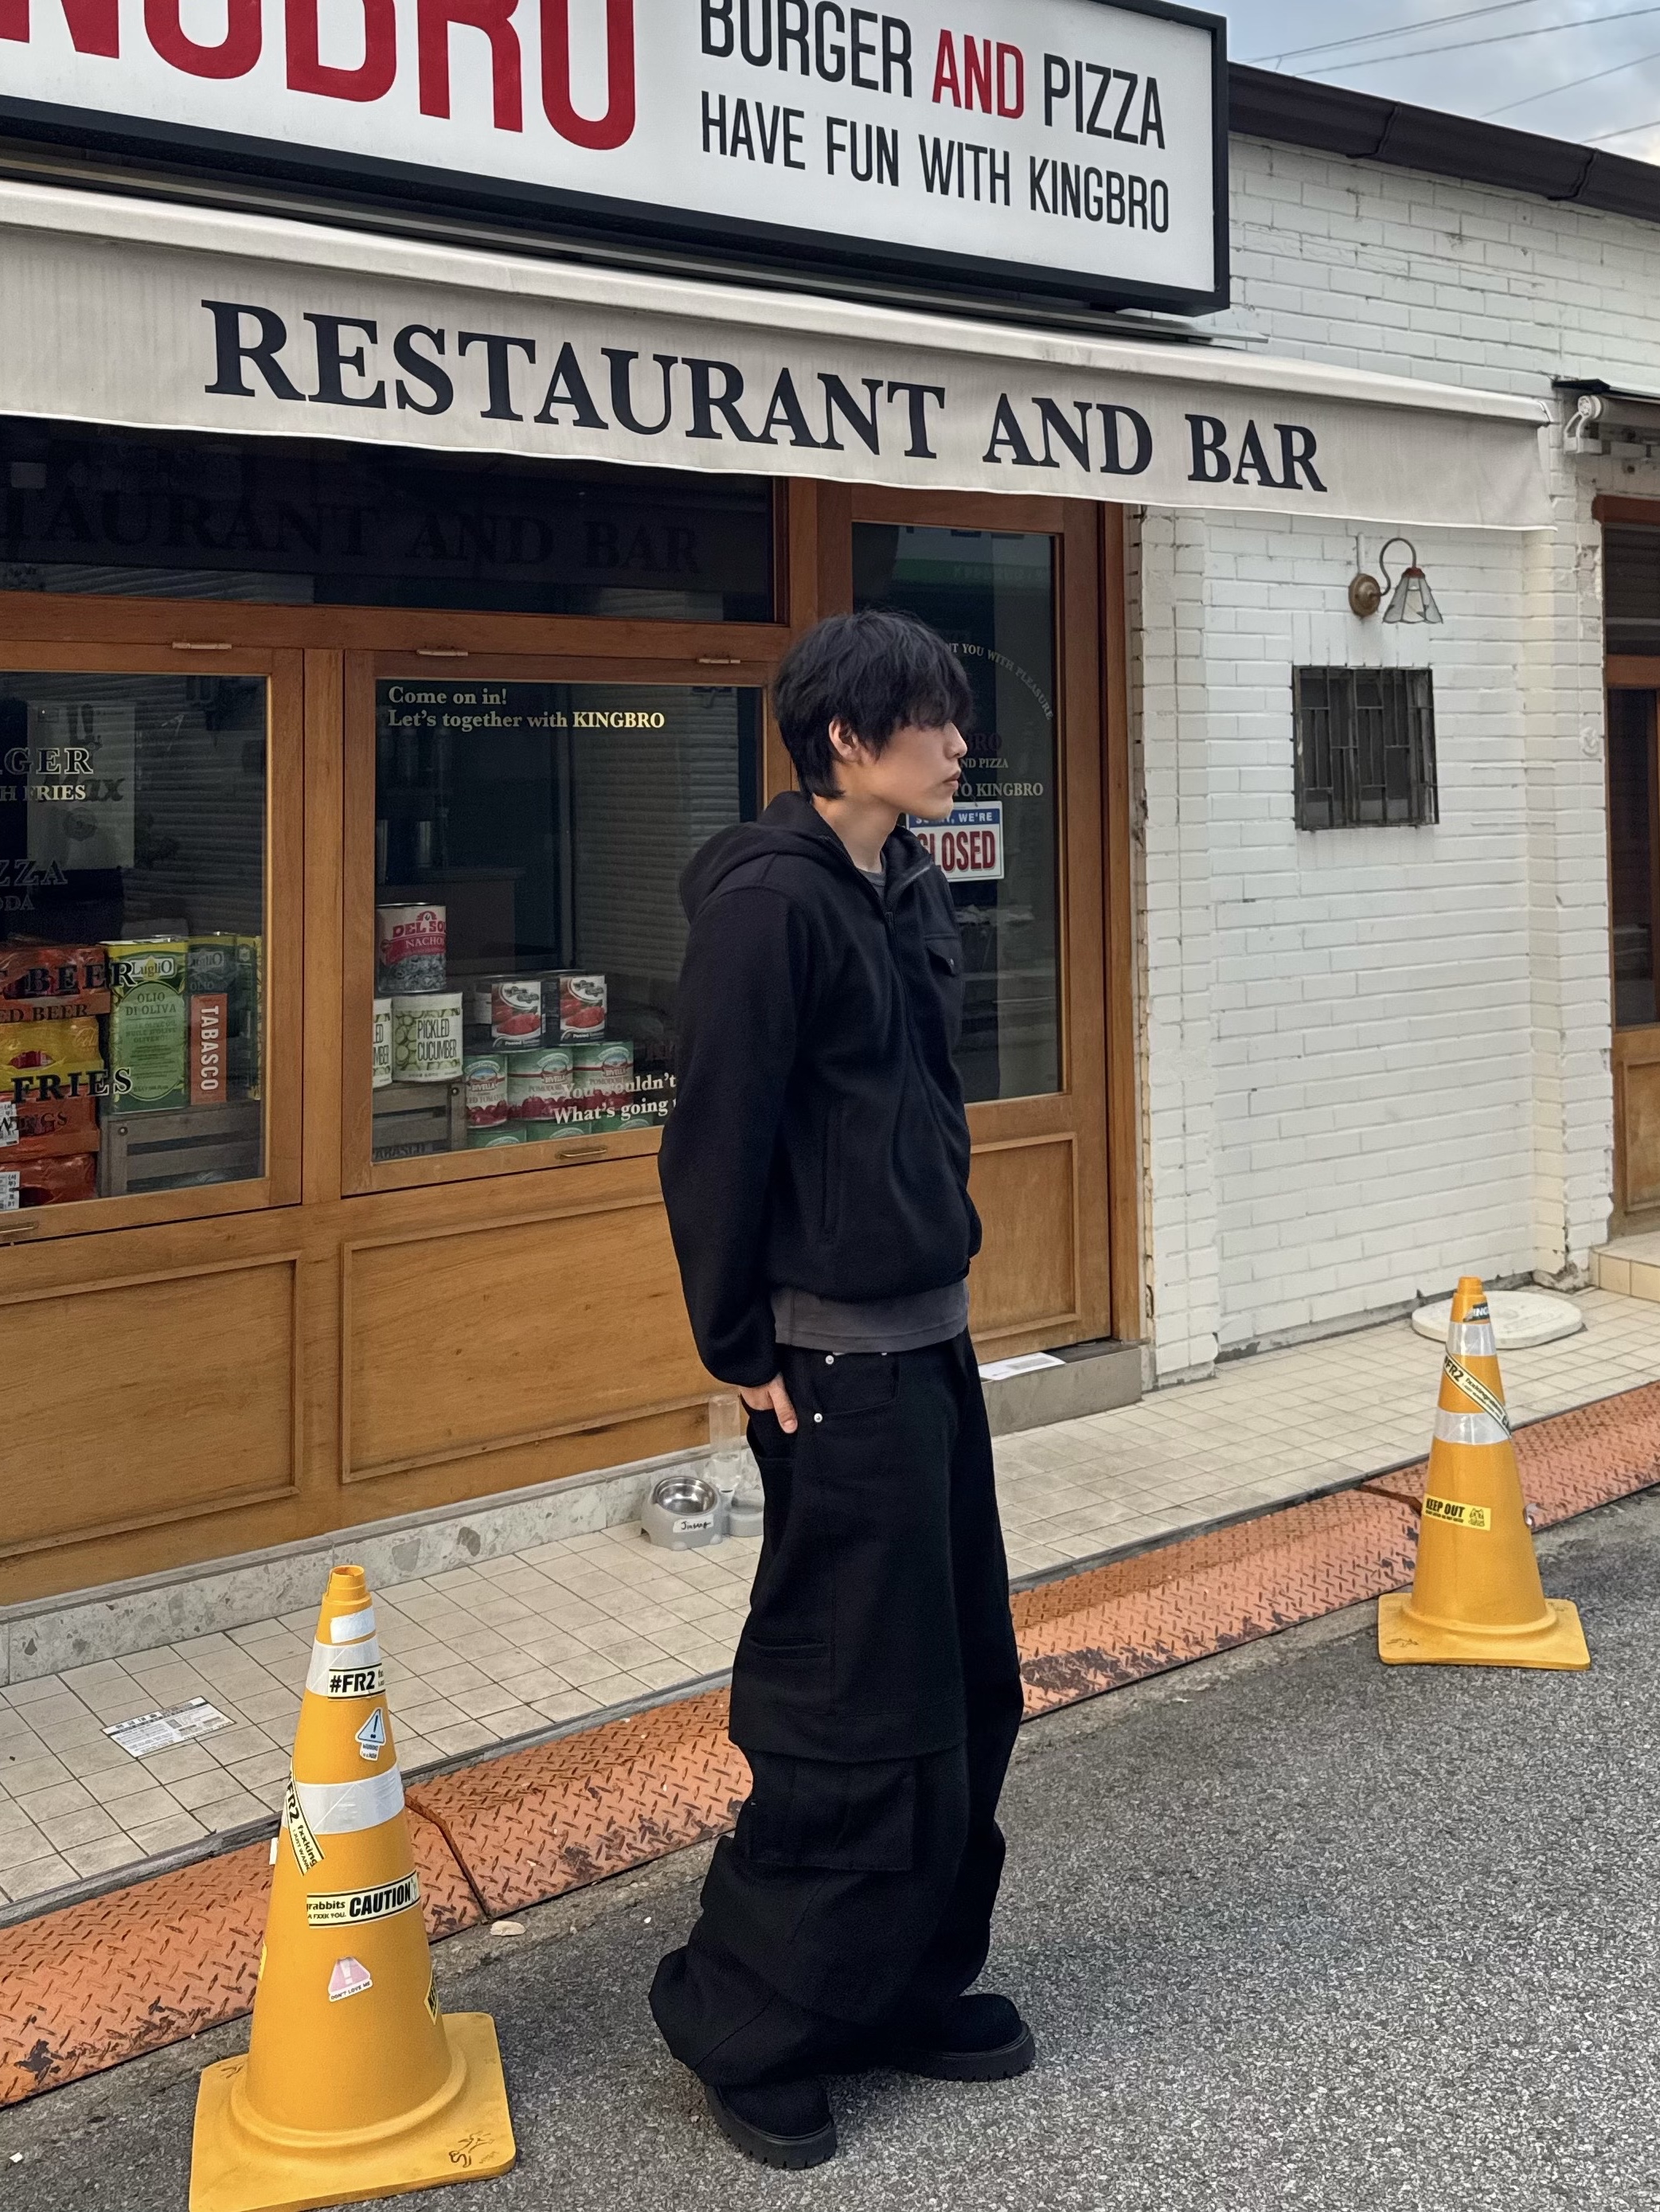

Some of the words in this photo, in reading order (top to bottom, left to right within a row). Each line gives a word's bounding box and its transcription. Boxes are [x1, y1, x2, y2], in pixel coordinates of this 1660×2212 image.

[701, 0, 912, 97] BURGER
[932, 29, 1024, 119] AND
[1045, 55, 1166, 150] PIZZA
[701, 91, 805, 170] HAVE
[826, 116, 899, 187] FUN
[918, 134, 1010, 206] WITH
[1029, 157, 1169, 233] KINGBRO
[201, 299, 945, 459] RESTAURANT
[983, 393, 1152, 475] AND
[1185, 413, 1327, 492] BAR
[406, 514, 553, 565] AND
[584, 520, 701, 573] BAR
[962, 643, 984, 656] YOU
[987, 649, 1014, 671] WITH
[1015, 666, 1053, 720] PLEASURE
[389, 686, 447, 704] Come
[453, 691, 476, 704] on
[482, 688, 507, 705] in!
[443, 711, 522, 732] together
[527, 711, 568, 729] with
[572, 711, 666, 729] KINGBRO
[0, 747, 94, 775] GER
[978, 757, 1009, 768] PIZZA
[23, 784, 86, 801] FRIES
[976, 782, 1044, 797] KINGBRO
[958, 812, 993, 823] WE'RE
[0, 895, 35, 911] DA
[393, 921, 426, 939] DEL
[26, 961, 139, 993] BEER
[137, 992, 166, 1003] OLIO
[33, 1003, 88, 1021] BEER
[126, 1006, 138, 1016] DI
[141, 1003, 177, 1015] OLIVA
[417, 1018, 450, 1039] PICKLED
[201, 1006, 220, 1091] TABASCO
[417, 1039, 457, 1061] CUCUMBER
[11, 1067, 132, 1104] FRIES
[561, 1083, 595, 1100] You
[620, 1097, 669, 1121] going
[1426, 1498, 1443, 1512] KEEP
[1444, 1503, 1466, 1518] OUT
[329, 1671, 376, 1693] #FR2
[287, 1776, 300, 1823] FR2
[297, 1824, 318, 1868] fxxking
[307, 1900, 346, 1910] rabbits
[349, 1881, 412, 1918] CAUTION
[348, 1984, 361, 1994] LOVE
